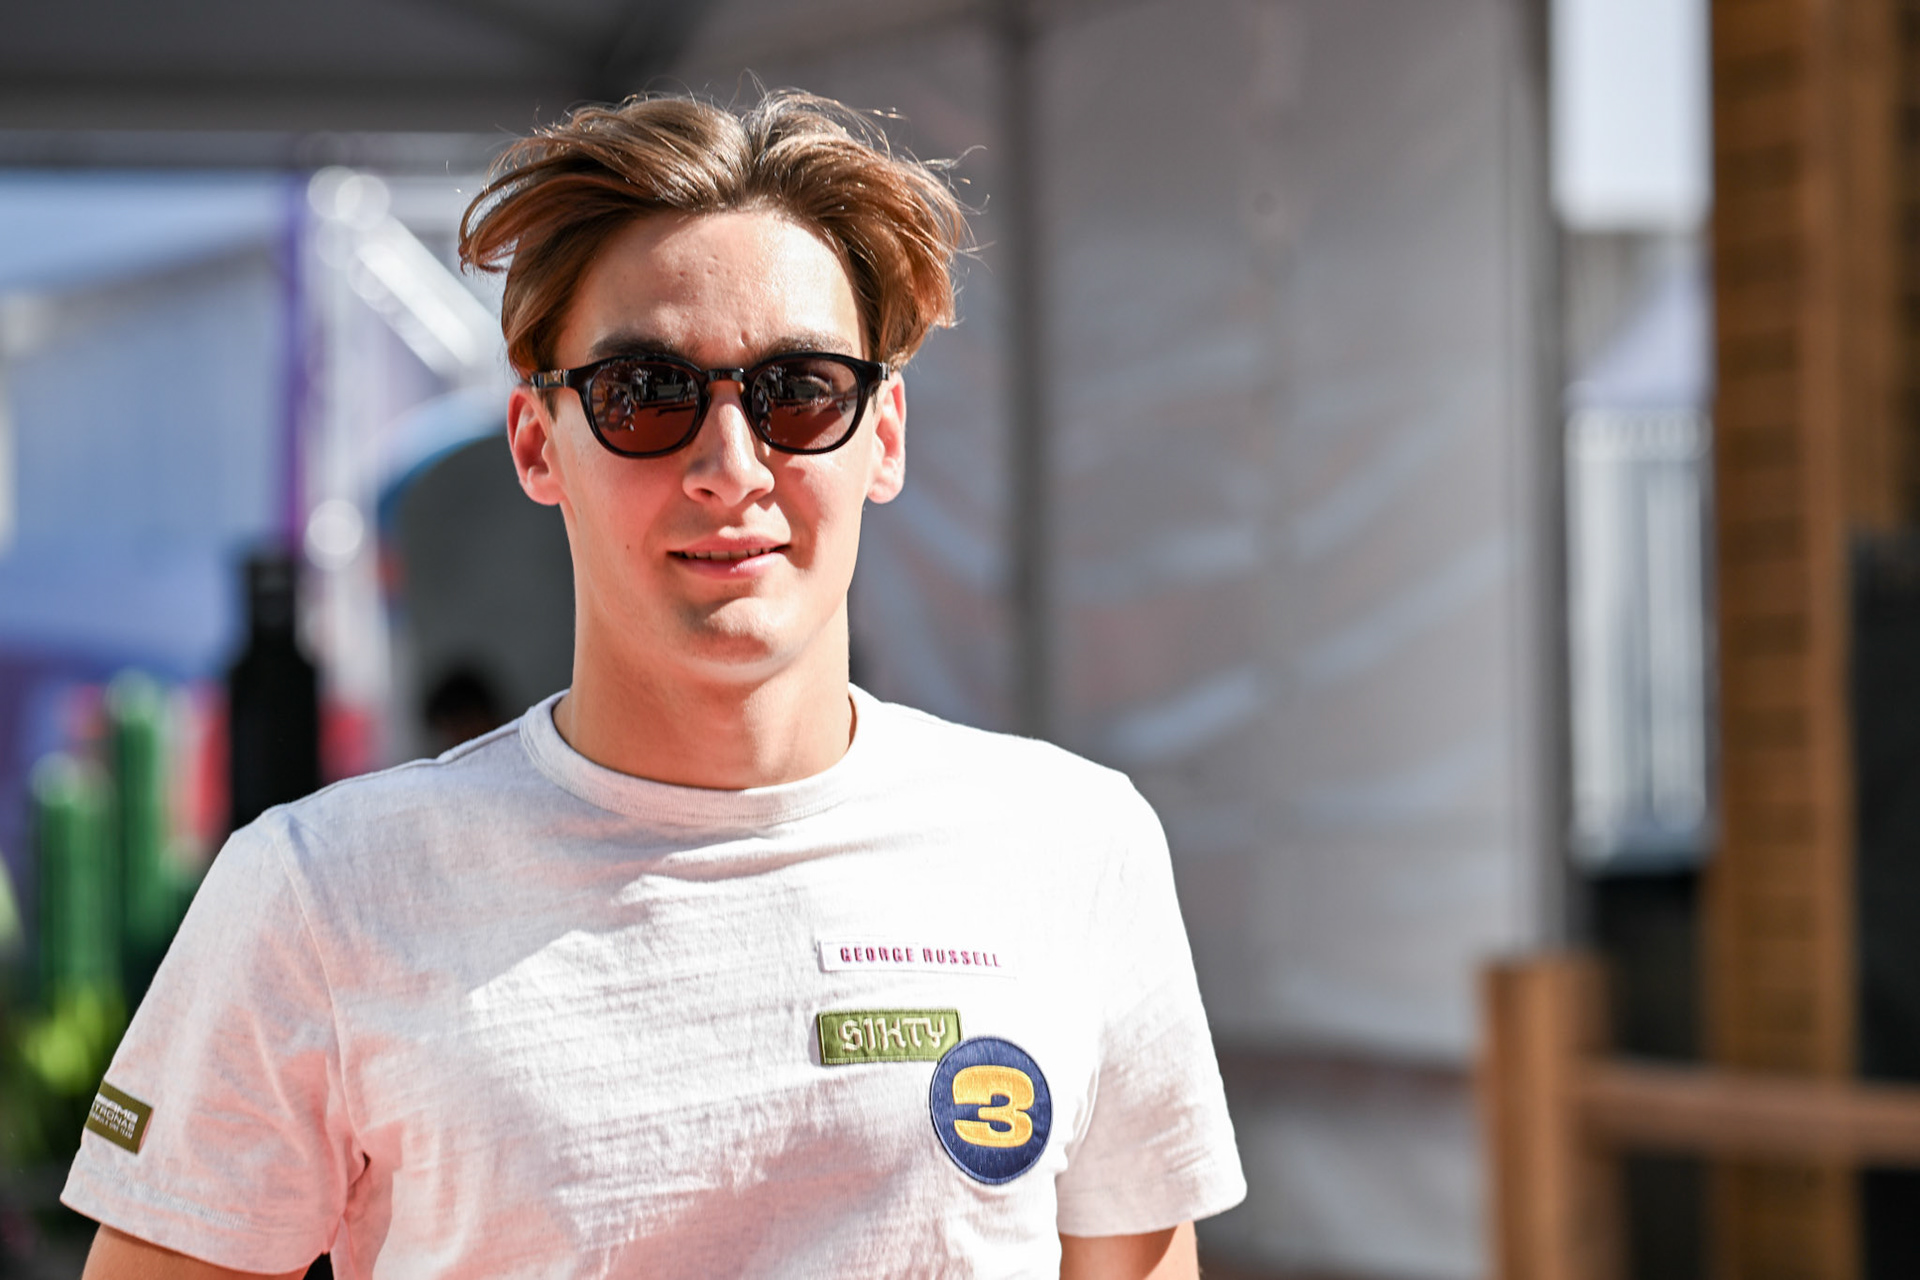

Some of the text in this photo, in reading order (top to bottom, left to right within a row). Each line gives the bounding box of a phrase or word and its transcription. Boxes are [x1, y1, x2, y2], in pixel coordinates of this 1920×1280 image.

[840, 946, 1002, 968] GEORGE RUSSELL
[952, 1064, 1035, 1148] 3
